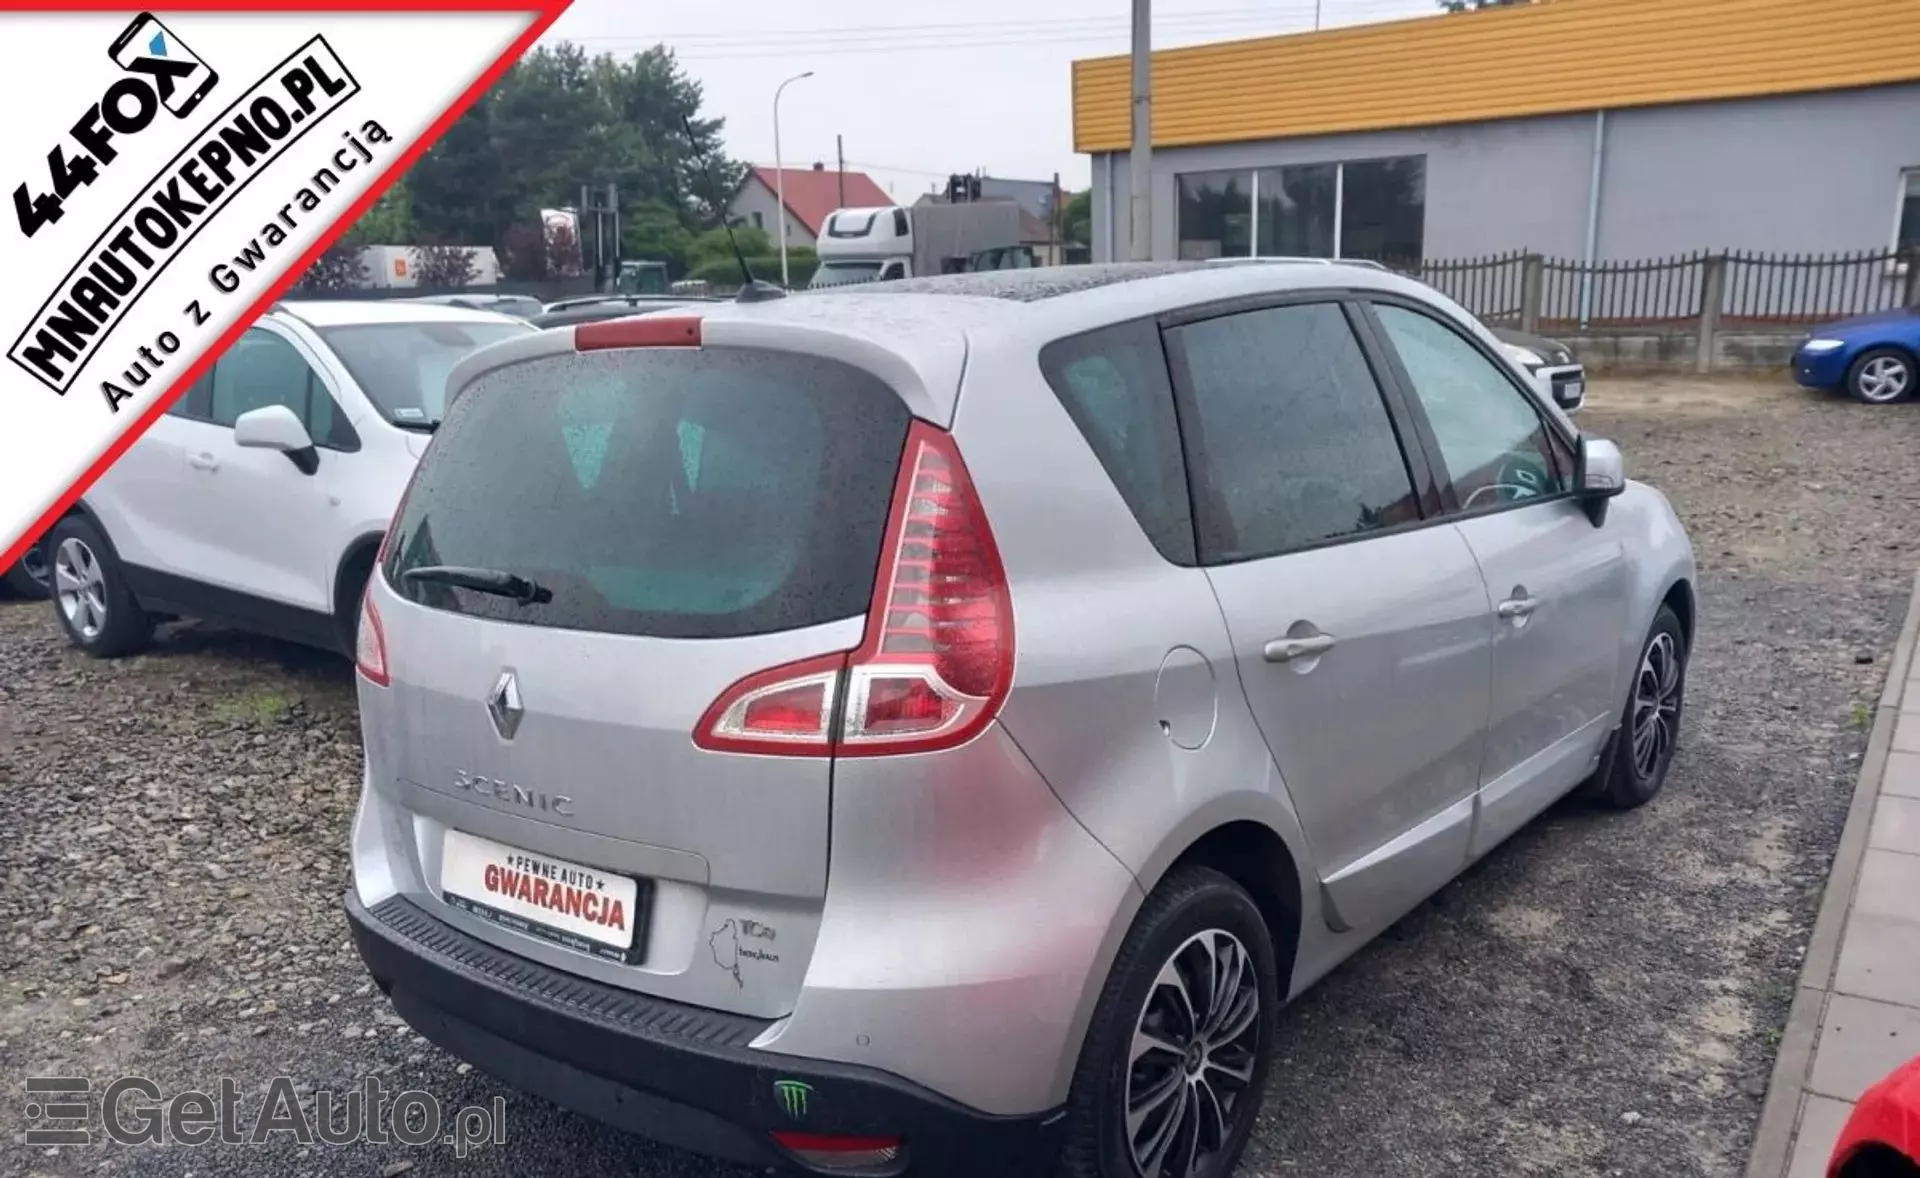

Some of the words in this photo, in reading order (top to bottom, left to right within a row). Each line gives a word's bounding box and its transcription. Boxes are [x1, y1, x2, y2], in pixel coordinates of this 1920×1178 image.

[454, 768, 575, 817] SCENIC
[516, 855, 557, 880] PEWNE
[561, 867, 594, 890] AUTO
[484, 864, 626, 931] GWARANCJA
